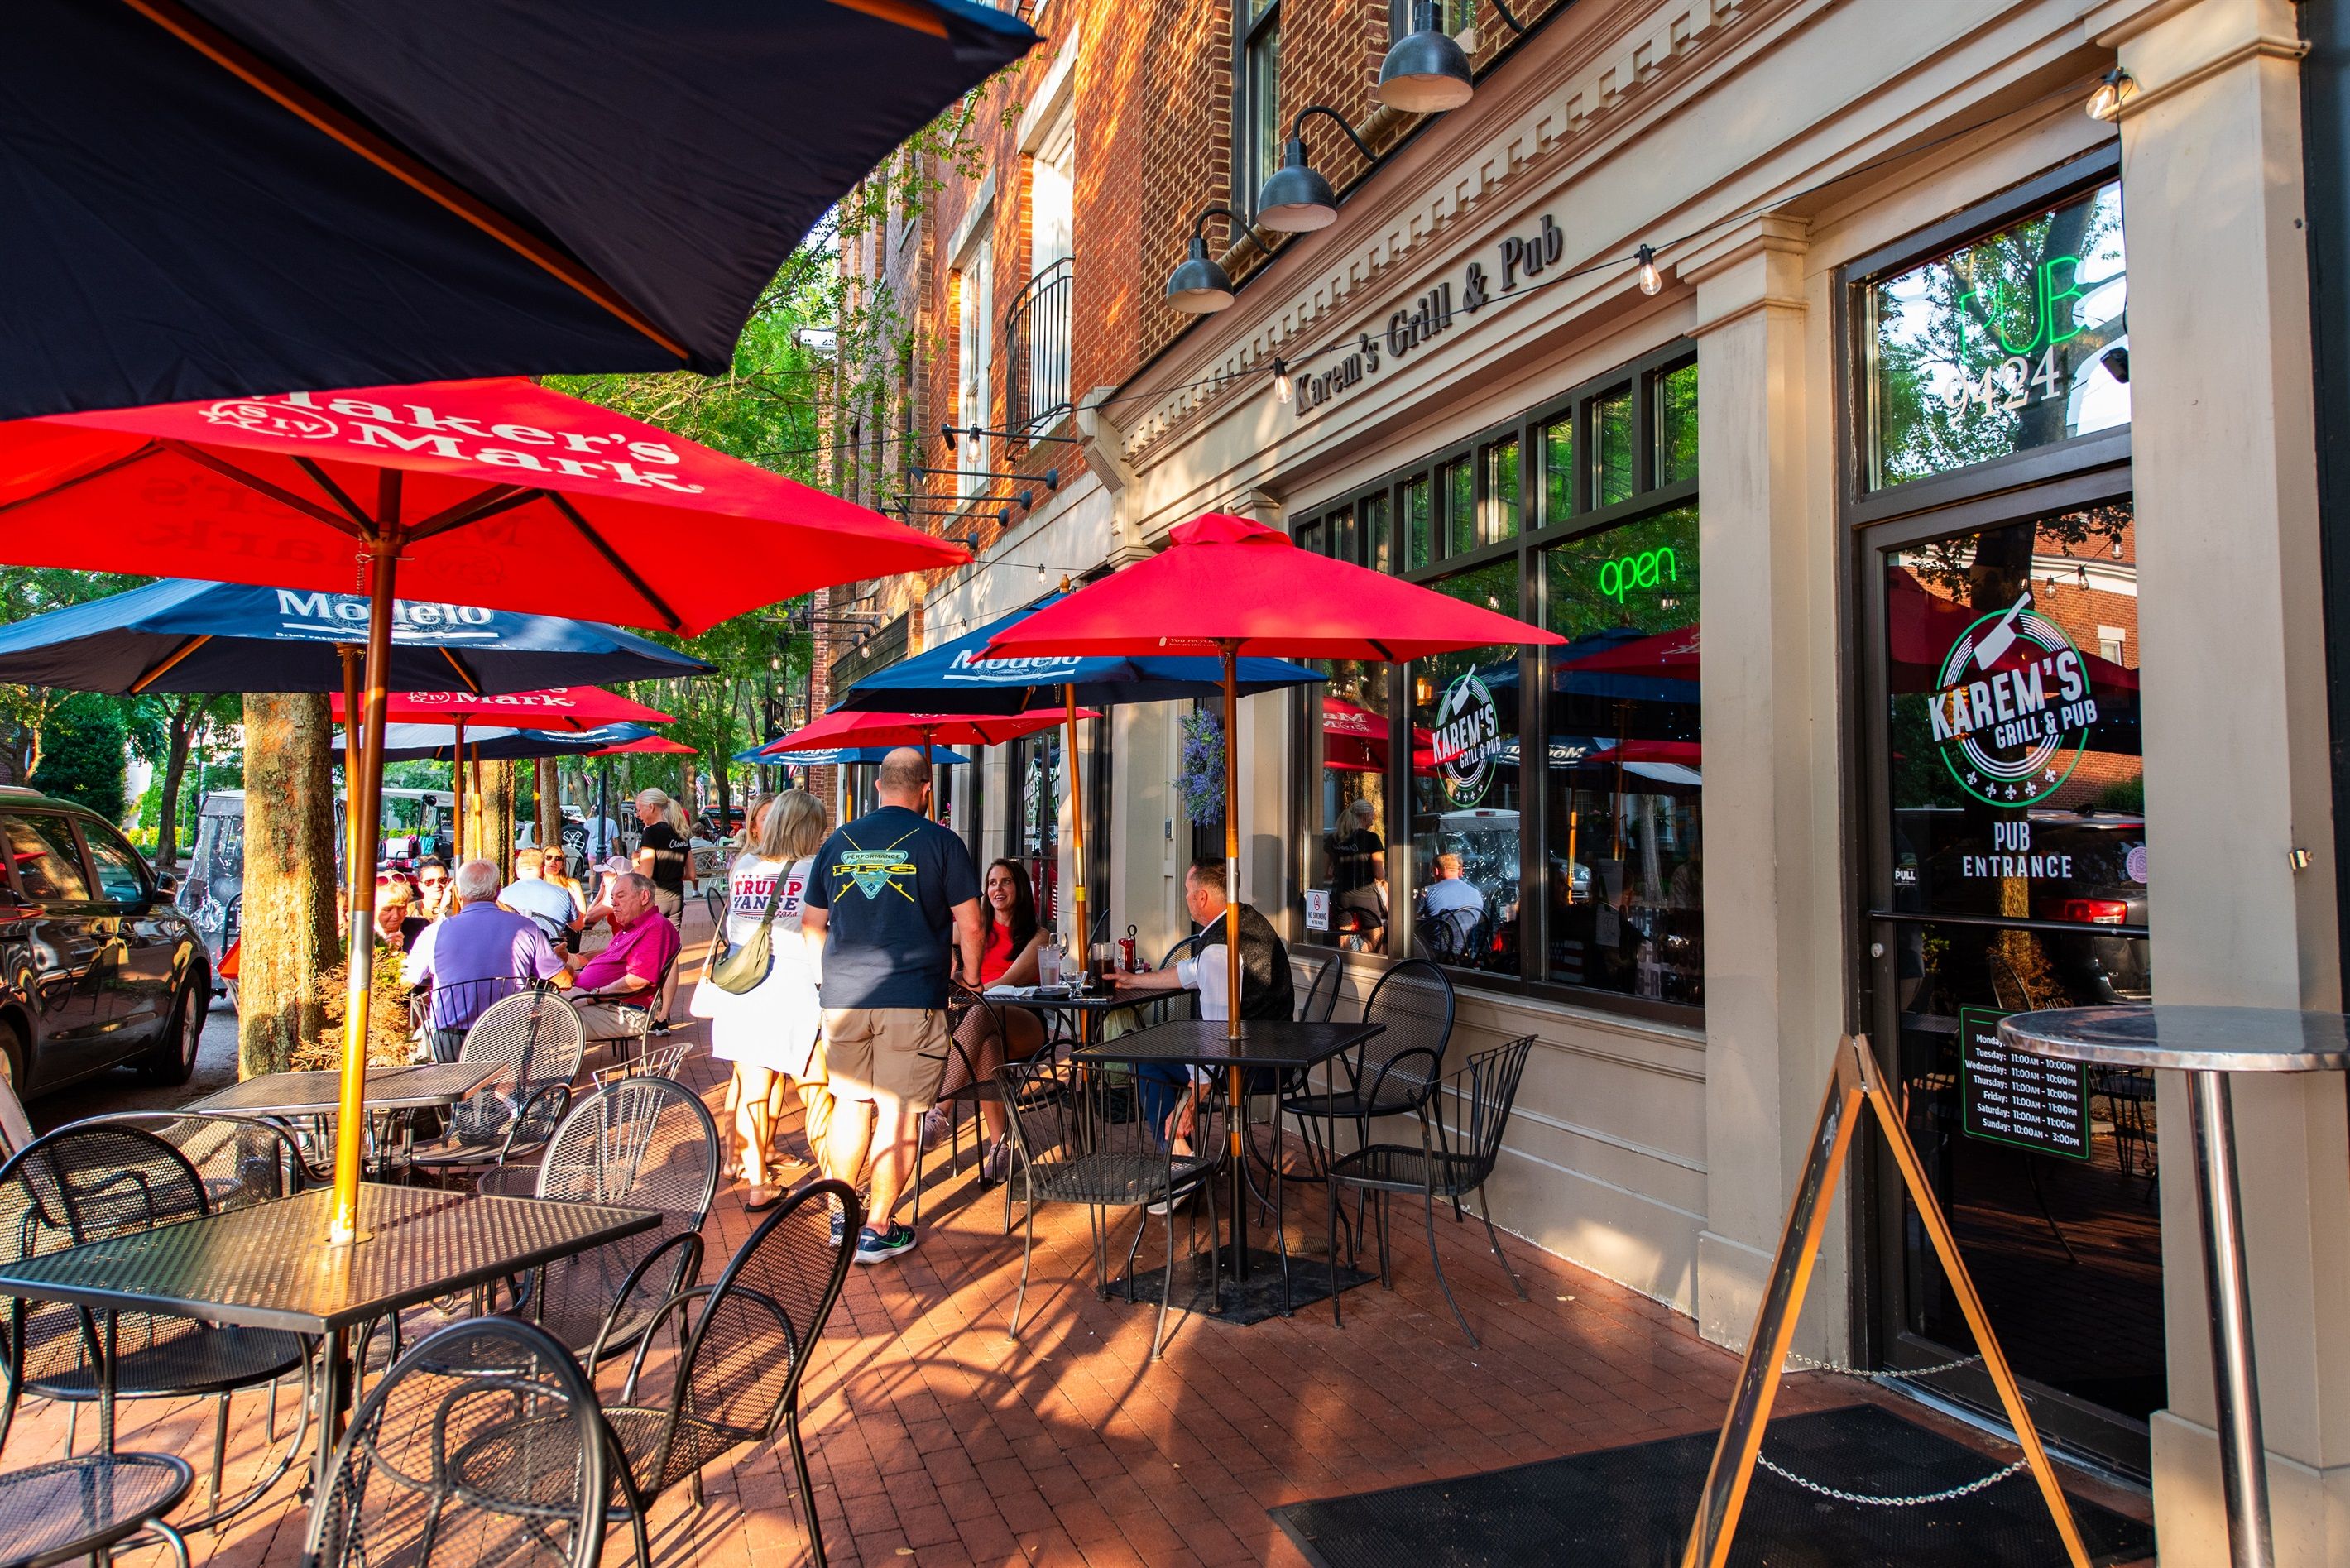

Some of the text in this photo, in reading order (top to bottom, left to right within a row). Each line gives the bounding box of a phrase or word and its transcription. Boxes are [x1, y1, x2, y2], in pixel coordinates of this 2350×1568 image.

[1294, 214, 1563, 416] Karem's Grill & Pub
[1961, 256, 2086, 366] PUB
[1945, 345, 2060, 427] 9424
[252, 391, 680, 465] aker's
[1600, 547, 1676, 604] open
[1928, 650, 2083, 742] KAREM'S
[1432, 703, 1495, 764] KAREM'S
[1994, 699, 2098, 749] GRILL & PUB
[1460, 736, 1501, 769] GRILL & PUB
[1993, 822, 2031, 851] PUB
[833, 864, 917, 876] PFG
[1895, 870, 1916, 880] PULL
[1963, 856, 2072, 878] ENTRANCE
[734, 896, 799, 910] VANE
[1964, 1060, 2007, 1076] Wednesday:
[2011, 1067, 2040, 1080] 11:00AM
[2045, 1073, 2077, 1086] 10:00PM
[1975, 1048, 2007, 1060] Tuesday:
[2011, 1053, 2039, 1066] 11:00AM
[2045, 1059, 2076, 1072] 10:00PM
[1974, 1075, 2007, 1089] Thursday:
[2012, 1081, 2040, 1095] 11:00AM
[2046, 1087, 2078, 1101] 10:00PM
[1977, 1103, 2011, 1118] Saturday:
[2012, 1110, 2041, 1124] 11:00AM
[2046, 1116, 2076, 1130] 11:00PM
[1983, 1091, 2008, 1103] Friday:
[2012, 1096, 2041, 1109] 11:00AM
[2048, 1102, 2078, 1116] 11:00PM
[1983, 1118, 2011, 1132] Sunday:
[2013, 1124, 2043, 1139] 10:00AM
[2052, 1132, 2079, 1146] 3:00PM
